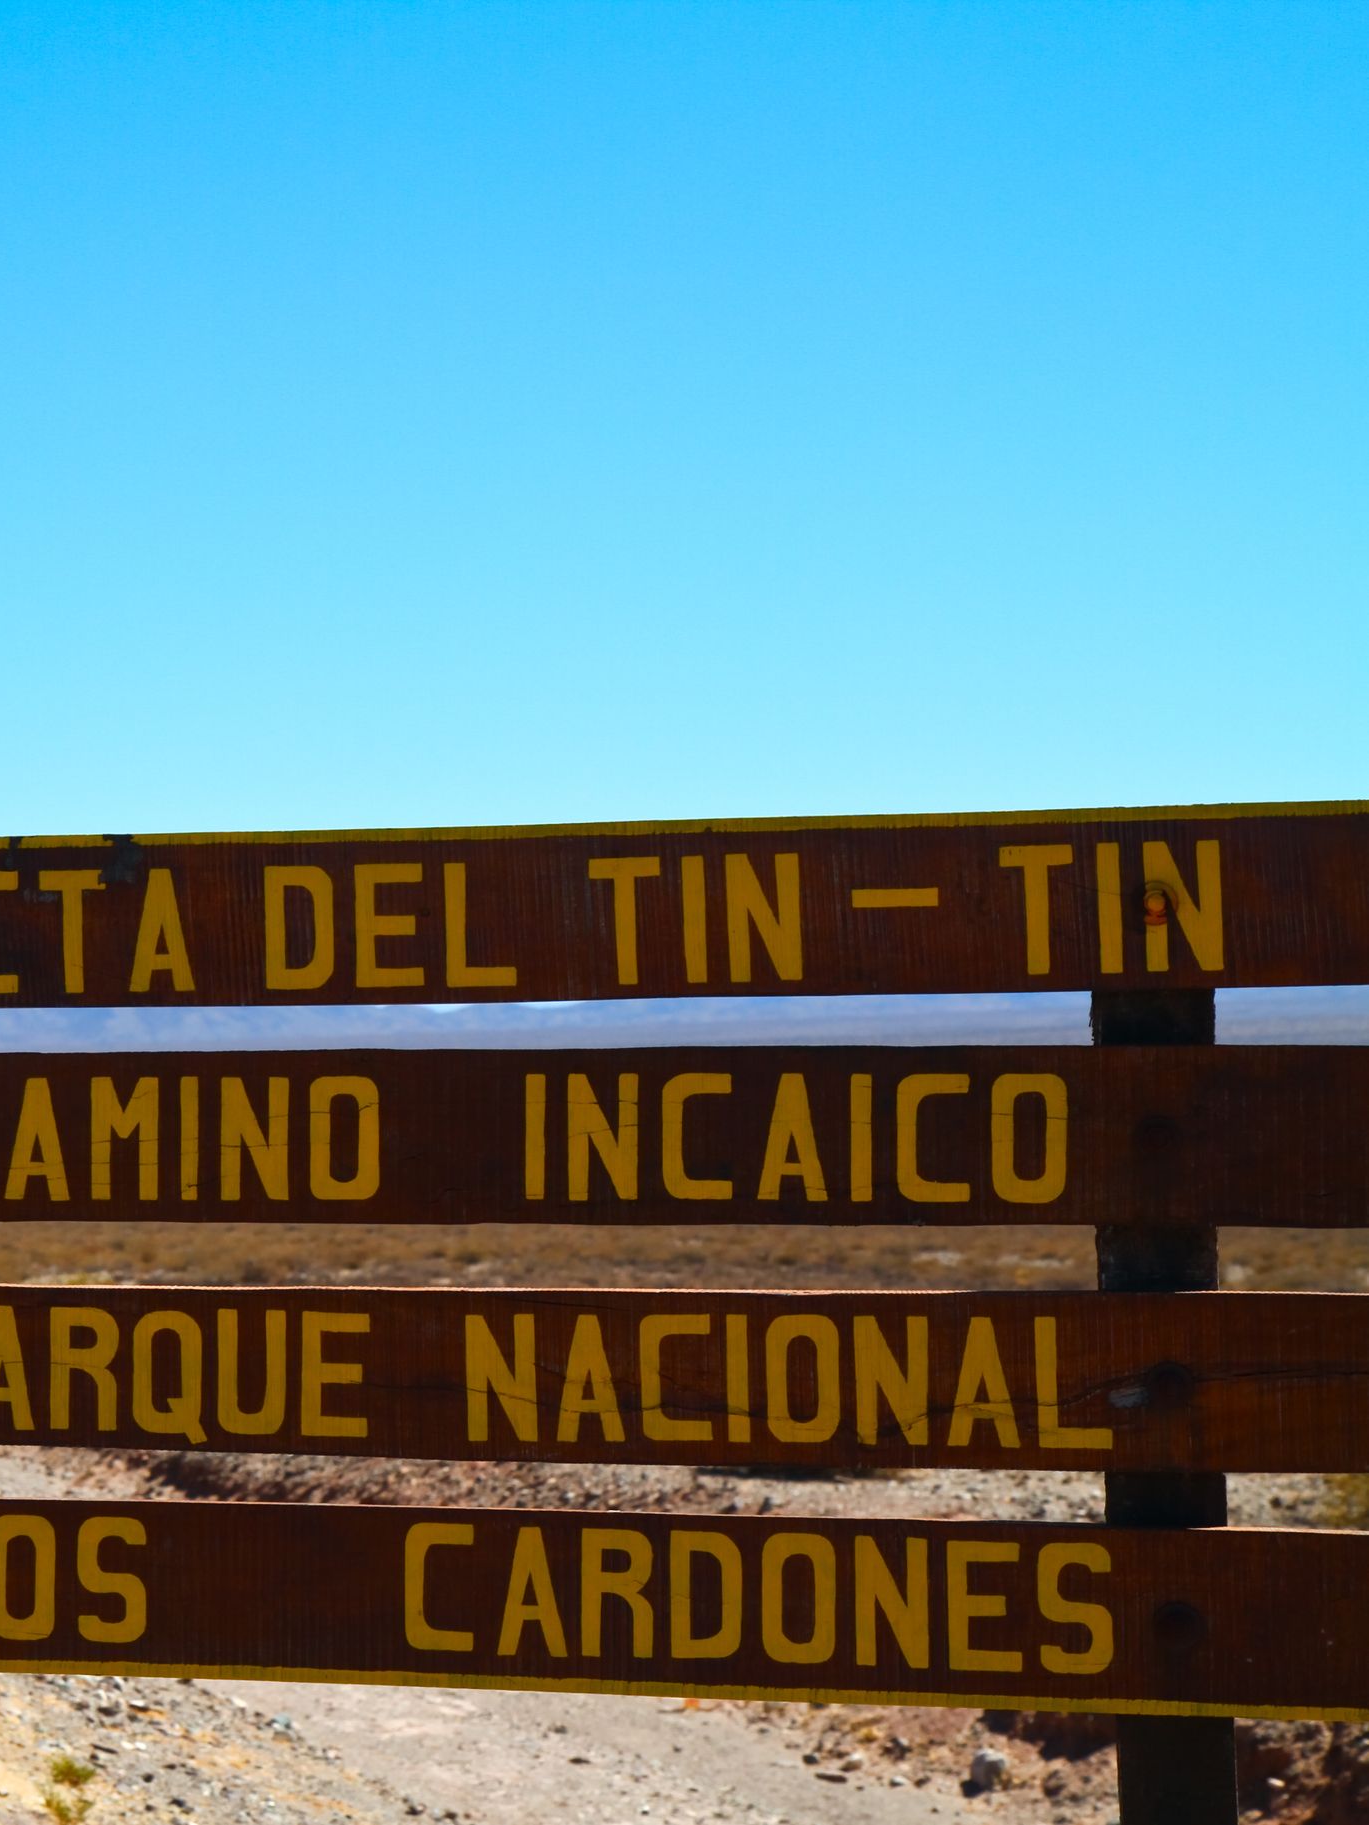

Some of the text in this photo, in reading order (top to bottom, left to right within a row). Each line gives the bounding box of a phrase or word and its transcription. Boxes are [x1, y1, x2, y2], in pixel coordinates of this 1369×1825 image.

[265, 864, 517, 990] DEL
[589, 854, 802, 985] TIN
[1000, 841, 1224, 975] TIN
[526, 1074, 1067, 1204] INCAICO
[466, 1314, 1112, 1449] NACIONAL
[404, 1523, 1113, 1675] CARDONES
